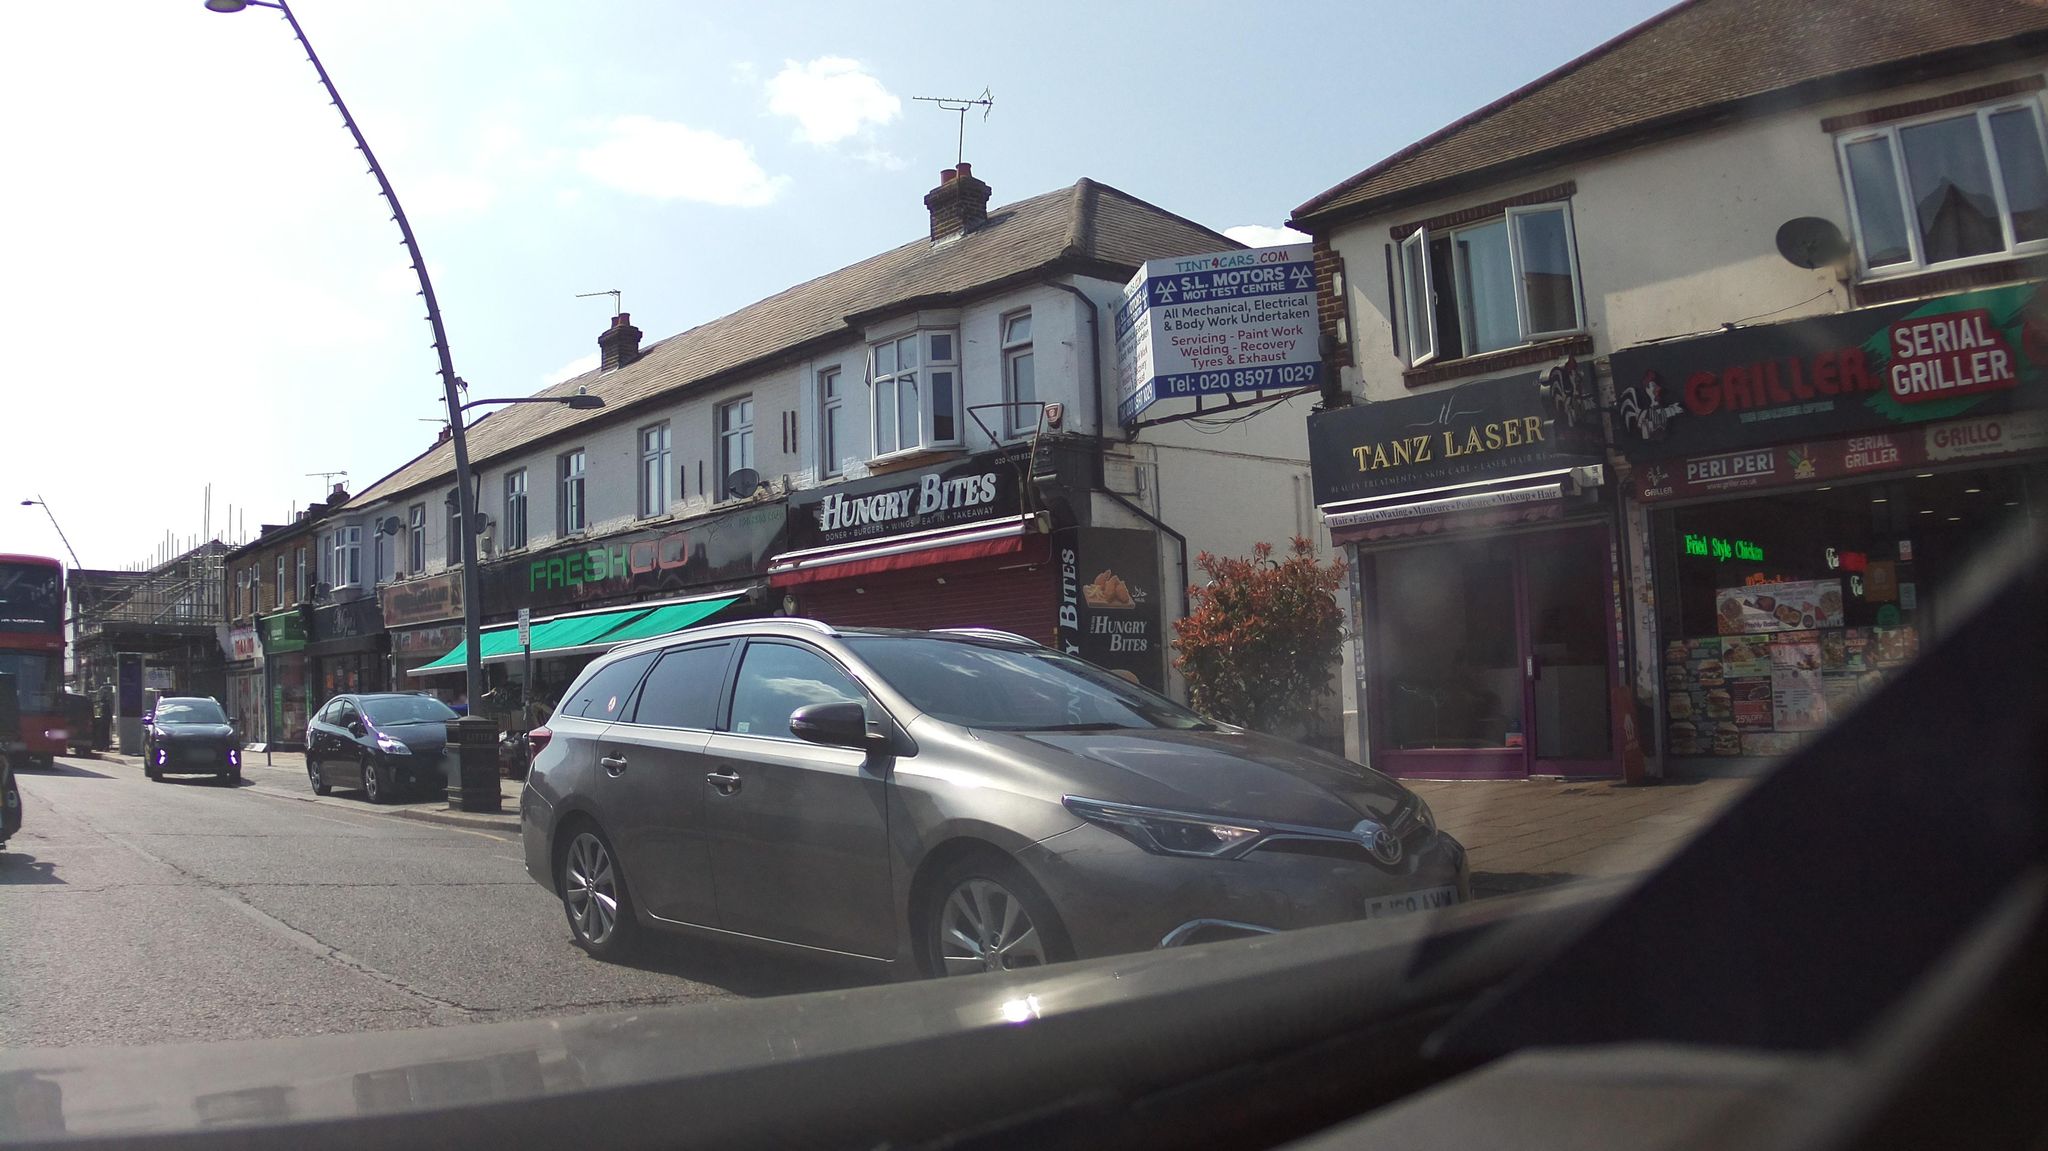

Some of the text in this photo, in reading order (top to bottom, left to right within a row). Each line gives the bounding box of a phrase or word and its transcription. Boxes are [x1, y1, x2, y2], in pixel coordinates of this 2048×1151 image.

[1175, 251, 1289, 273] TINT4CARS.COM
[1181, 267, 1285, 291] S.L. MOTORS
[1182, 282, 1286, 301] MOT TEST CENTRE
[1163, 296, 1309, 320] All Mechanical, Electrical
[1163, 308, 1310, 332] & Body Work Undertaken
[1171, 325, 1304, 346] Servicing Paint Work
[1895, 316, 1996, 358] SERIAL
[1180, 340, 1296, 358] Welding Recovery
[1191, 351, 1286, 370] Tyres & Exhaust
[1167, 365, 1314, 393] Tel: 020 8597 1029
[1352, 415, 1545, 473] TANZ LASER
[1847, 435, 1893, 453] SERIAL
[1934, 422, 2001, 448] GRILLO
[1687, 452, 1775, 481] PERI PERI
[1845, 448, 1898, 469] GRILLER
[1364, 473, 1417, 488] TREATMENTS
[1425, 468, 1445, 479] SKIN
[1448, 464, 1472, 477] CARE
[1480, 459, 1508, 470] LASER
[1510, 454, 1532, 465] HAIR
[821, 488, 915, 532] HUNGRY
[917, 473, 997, 515] BITES
[1644, 486, 1673, 497] GRILLER
[1331, 489, 1557, 527] Hair Facial Waxing Manicure Pedicure Makeup Hair
[825, 507, 993, 542] DONER BURGERS WINGS EAT IN TAKEAWAY
[1711, 538, 1732, 563] Style
[530, 534, 688, 592] FRESHCO
[1059, 548, 1079, 631] BITES
[1094, 615, 1147, 634] HUNGRY
[1110, 633, 1148, 652] BITES
